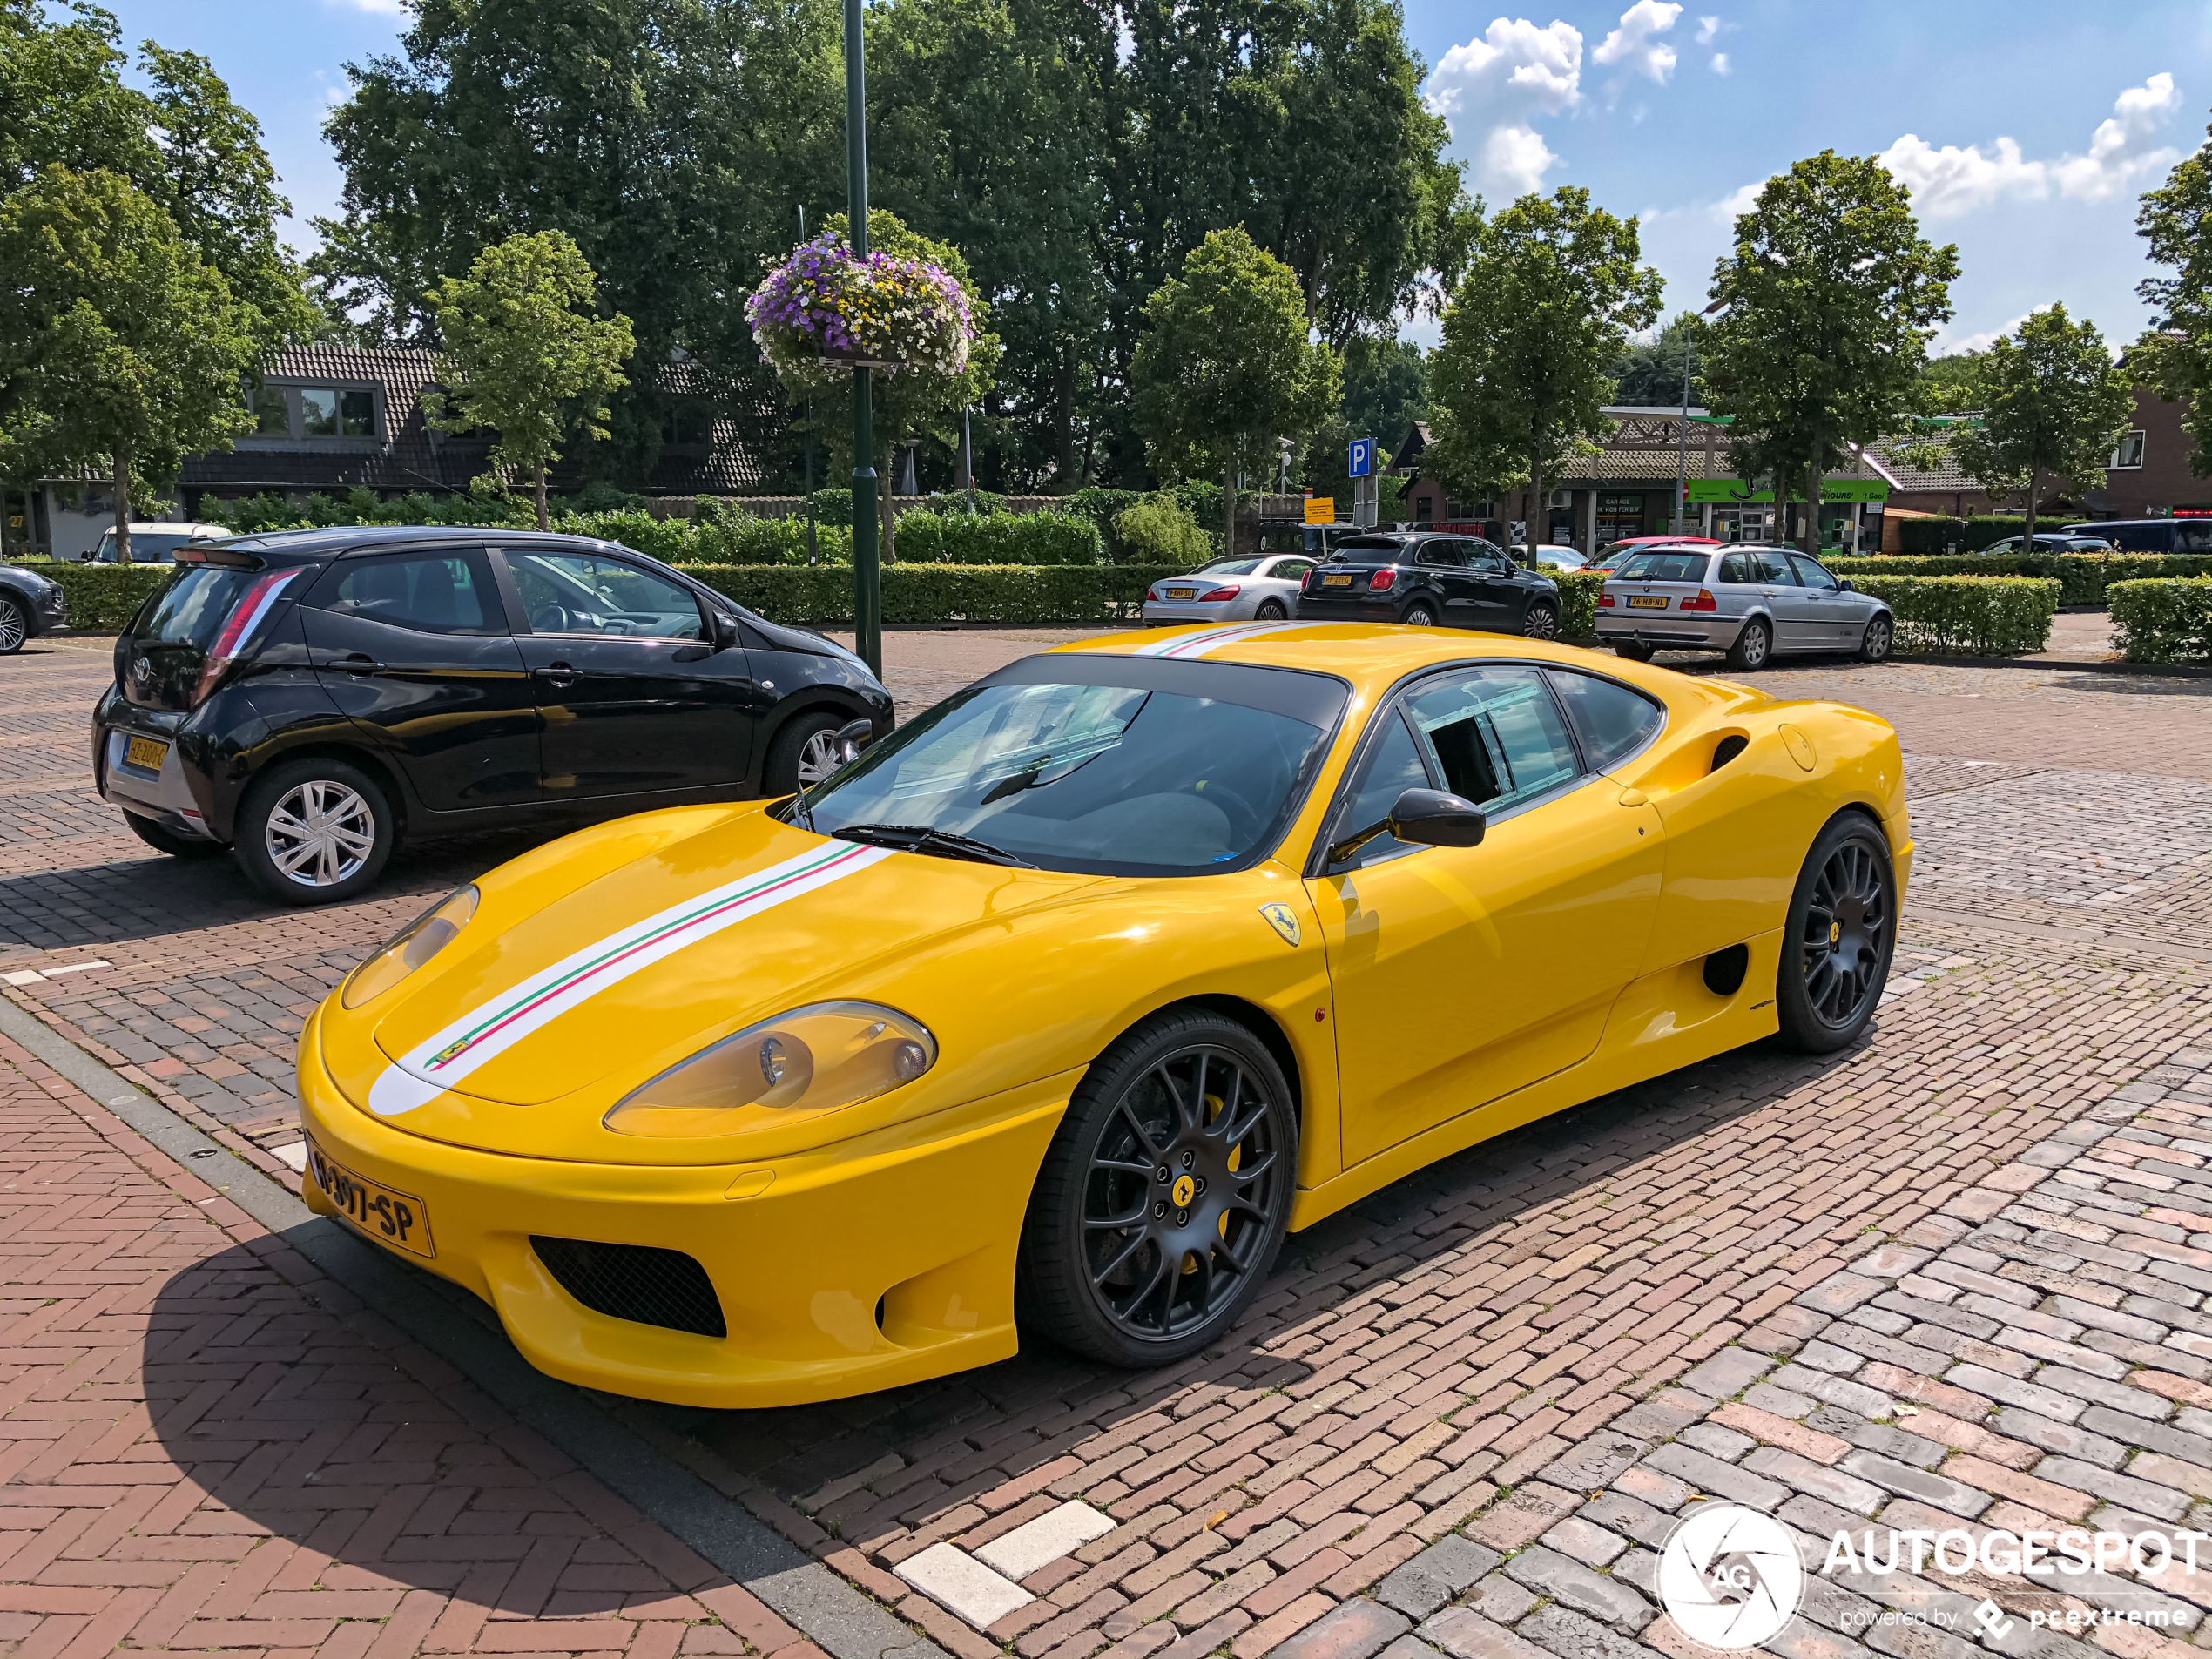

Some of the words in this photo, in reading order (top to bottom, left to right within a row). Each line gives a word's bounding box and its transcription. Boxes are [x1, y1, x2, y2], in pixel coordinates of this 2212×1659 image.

[1353, 444, 1366, 472] P
[10, 515, 24, 528] 27
[1632, 597, 1664, 606] 76-HB-NL
